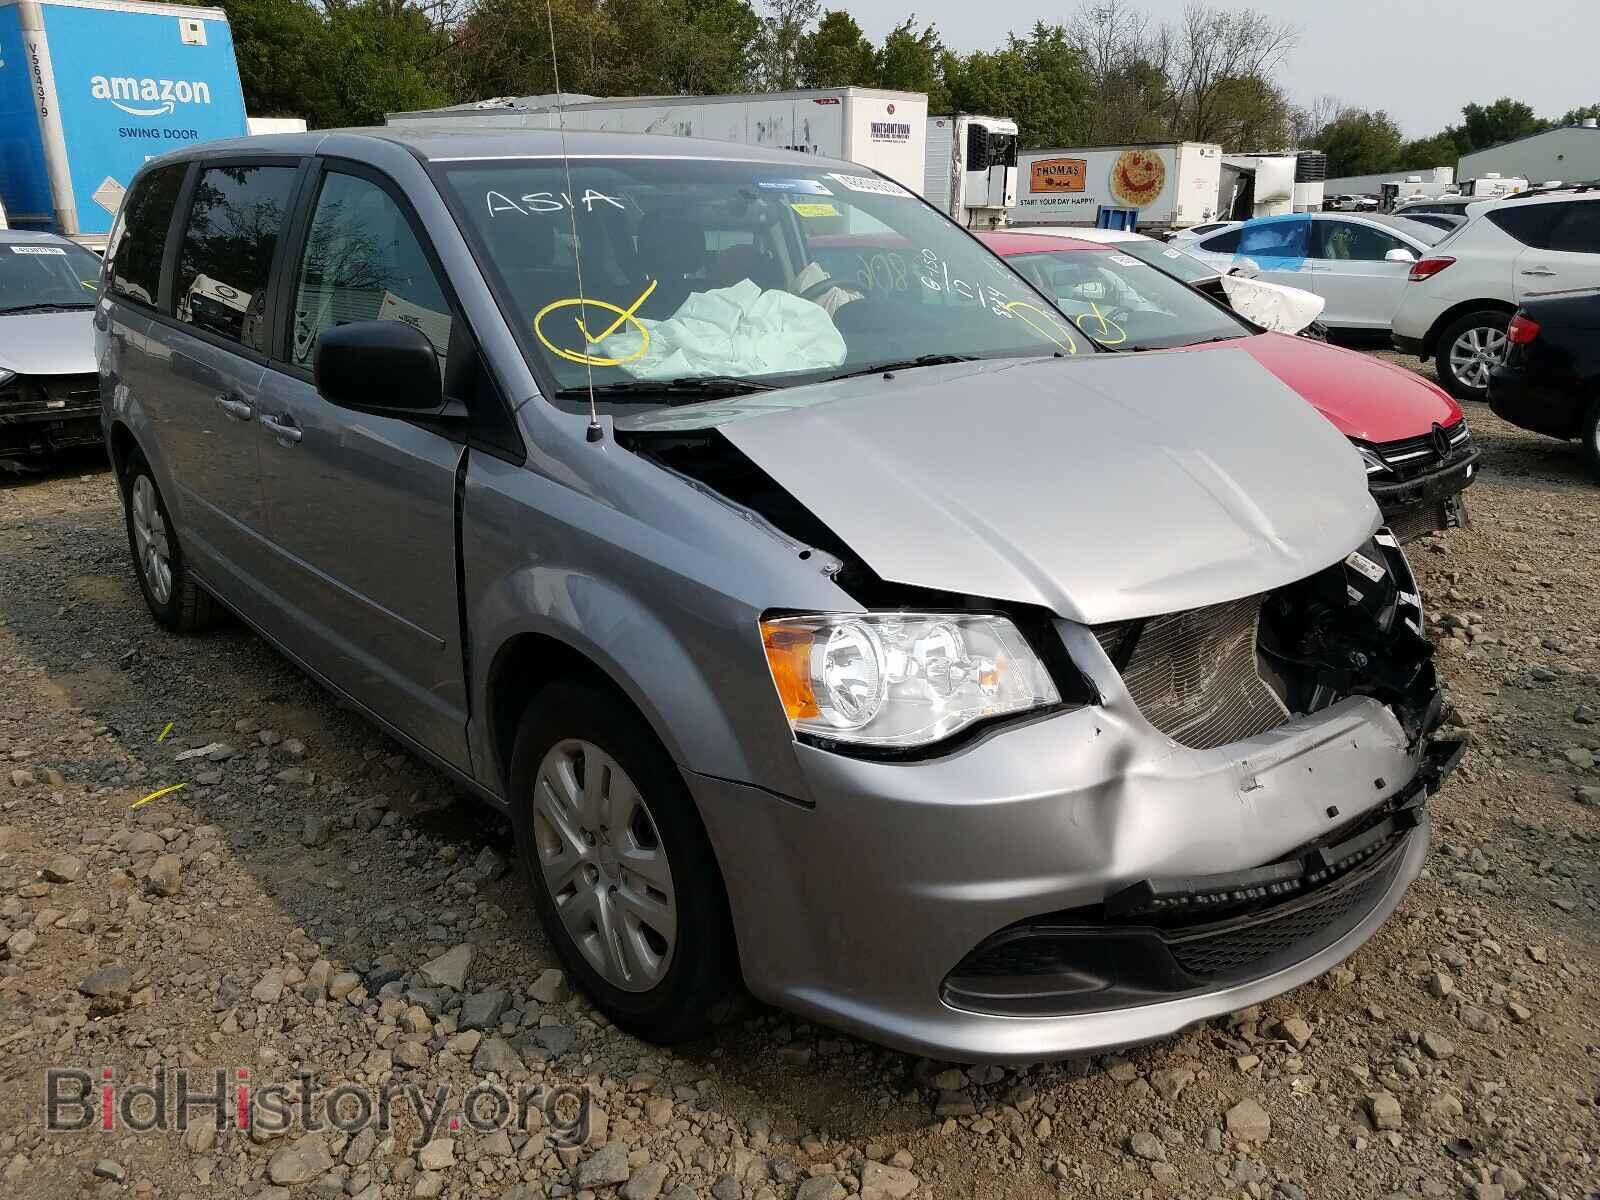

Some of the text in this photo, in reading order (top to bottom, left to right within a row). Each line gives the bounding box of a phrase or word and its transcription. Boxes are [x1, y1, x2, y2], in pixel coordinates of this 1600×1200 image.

[90, 75, 210, 105] amazon
[118, 127, 198, 140] SWING DOOR
[486, 189, 625, 218] ASIA
[1020, 197, 1095, 206] START YOUR DAY HAPPY!
